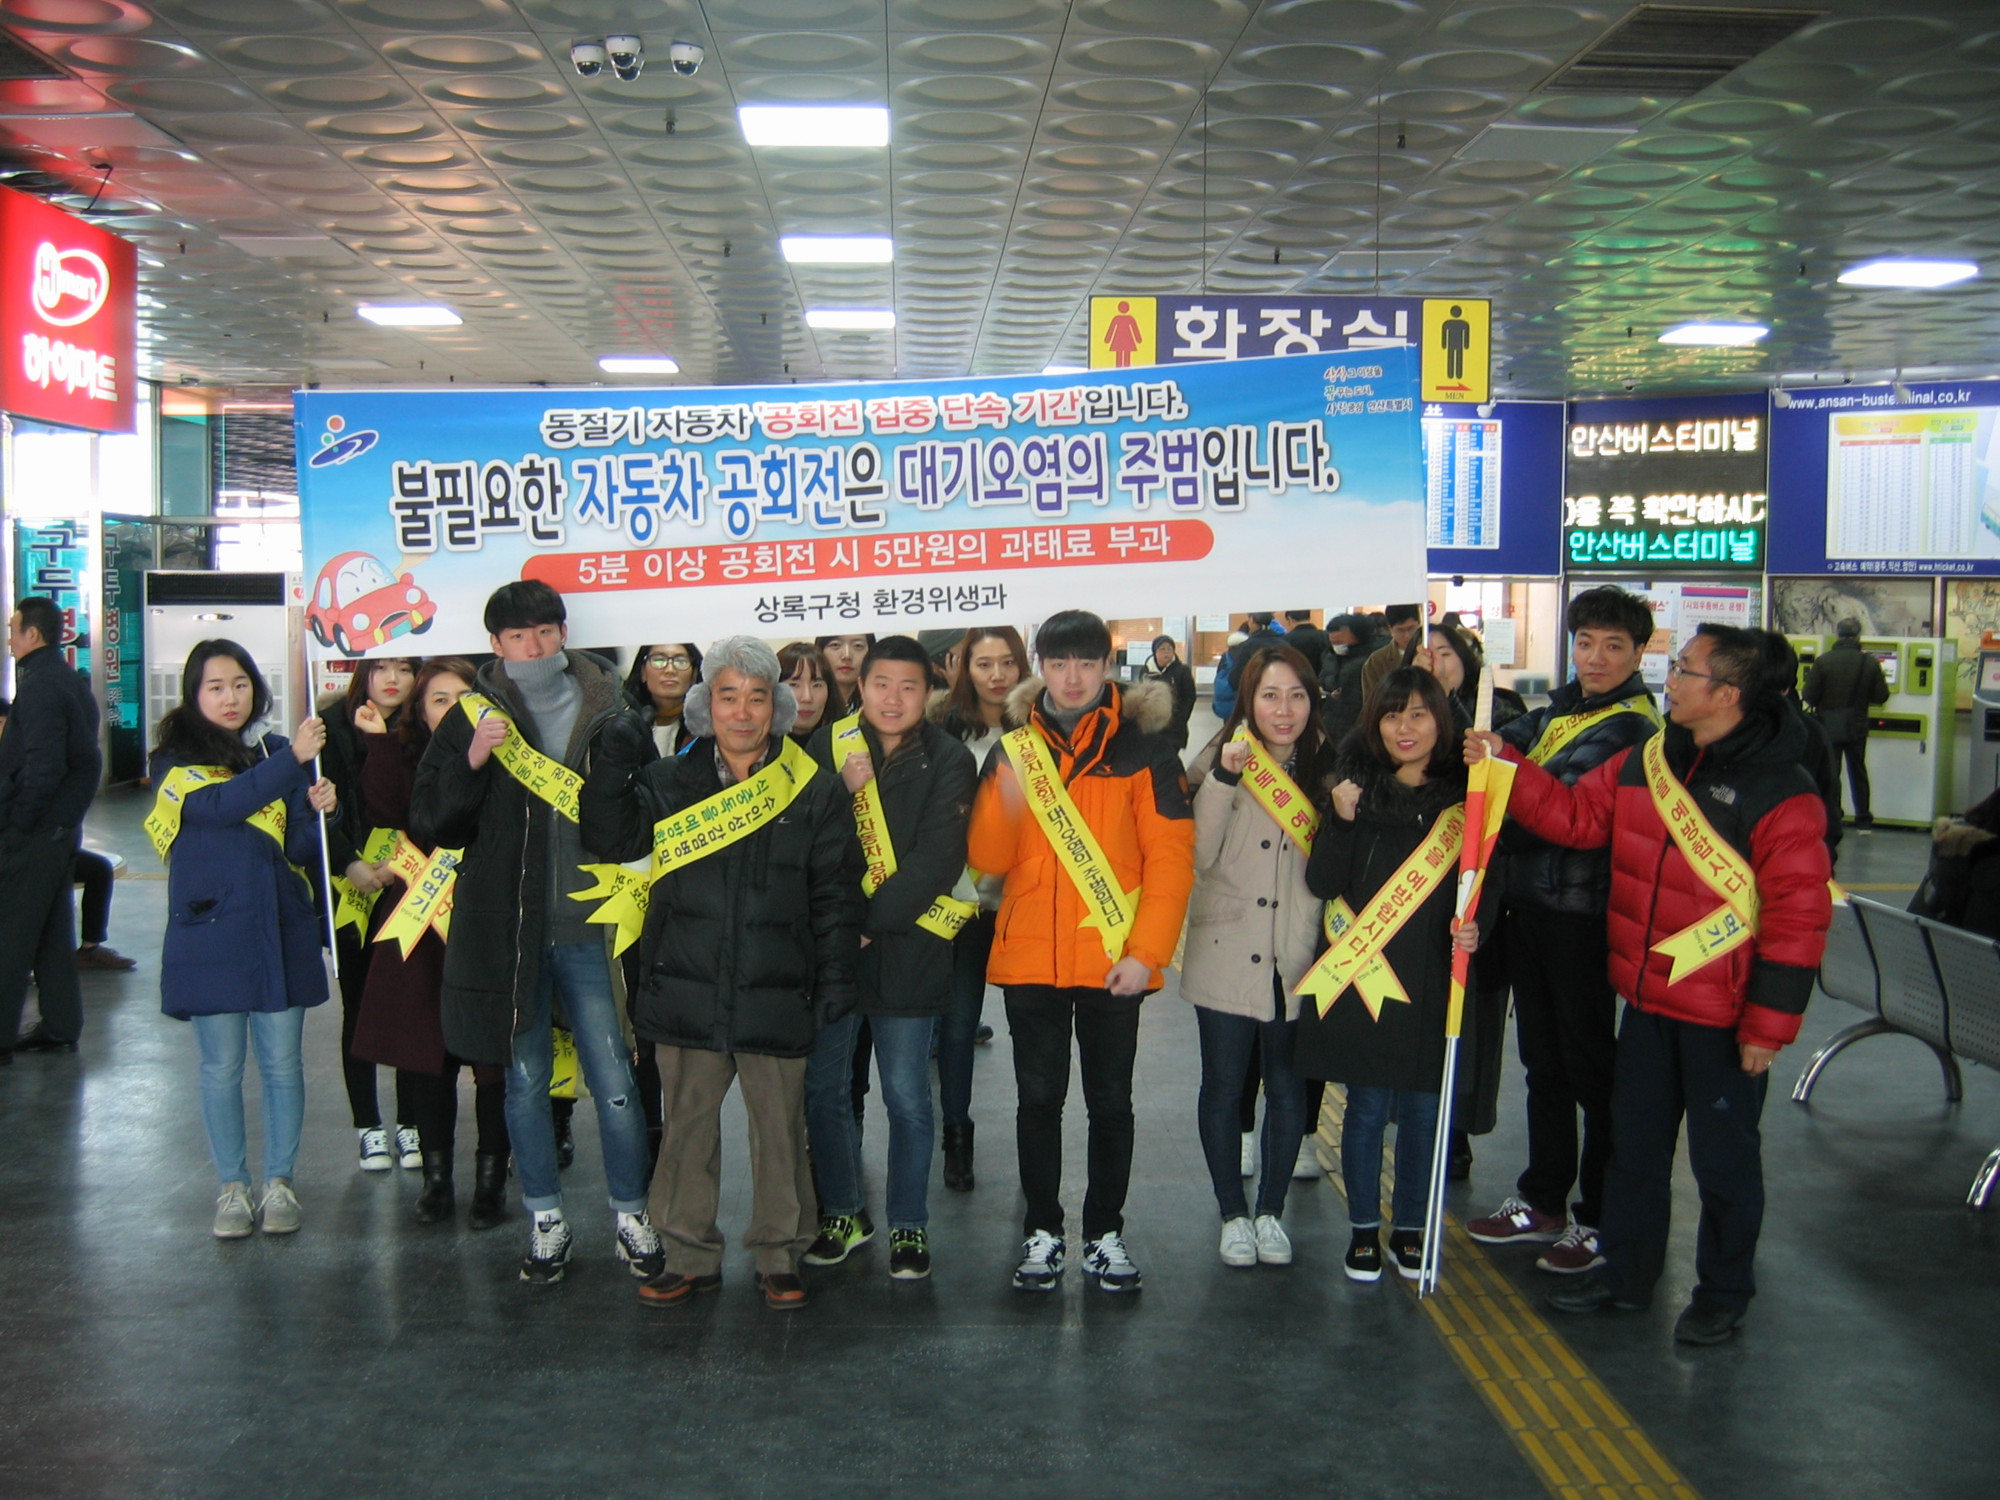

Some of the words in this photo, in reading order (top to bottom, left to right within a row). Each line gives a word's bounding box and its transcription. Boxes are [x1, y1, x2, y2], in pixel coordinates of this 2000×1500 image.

[22, 333, 118, 402] 하이마트
[545, 410, 640, 443] 동절기
[652, 407, 748, 437] 자동차
[871, 399, 933, 428] 집중
[944, 394, 1006, 425] 단속
[1445, 391, 1465, 400] MEN
[1570, 417, 1760, 457] 안산버스터미널
[395, 457, 562, 547] 불필요한
[577, 453, 703, 542] 자동차
[718, 448, 883, 536] 공회전은
[900, 437, 1104, 512] 대기오염의
[1121, 424, 1335, 505] 주범입니다.
[578, 554, 629, 584] 5분
[643, 549, 707, 582] 이상
[719, 541, 816, 579] 공회전
[828, 538, 859, 572] 시
[873, 531, 987, 569] 5만원의
[1000, 527, 1096, 562] 과태료
[1107, 524, 1171, 557] 부과
[1568, 529, 1758, 563] 안산버스터미널
[754, 590, 861, 623] 상록구청
[873, 582, 1007, 617] 환경위생과
[1047, 804, 1094, 869] 대기오염의
[1083, 864, 1126, 929] 주범입니다
